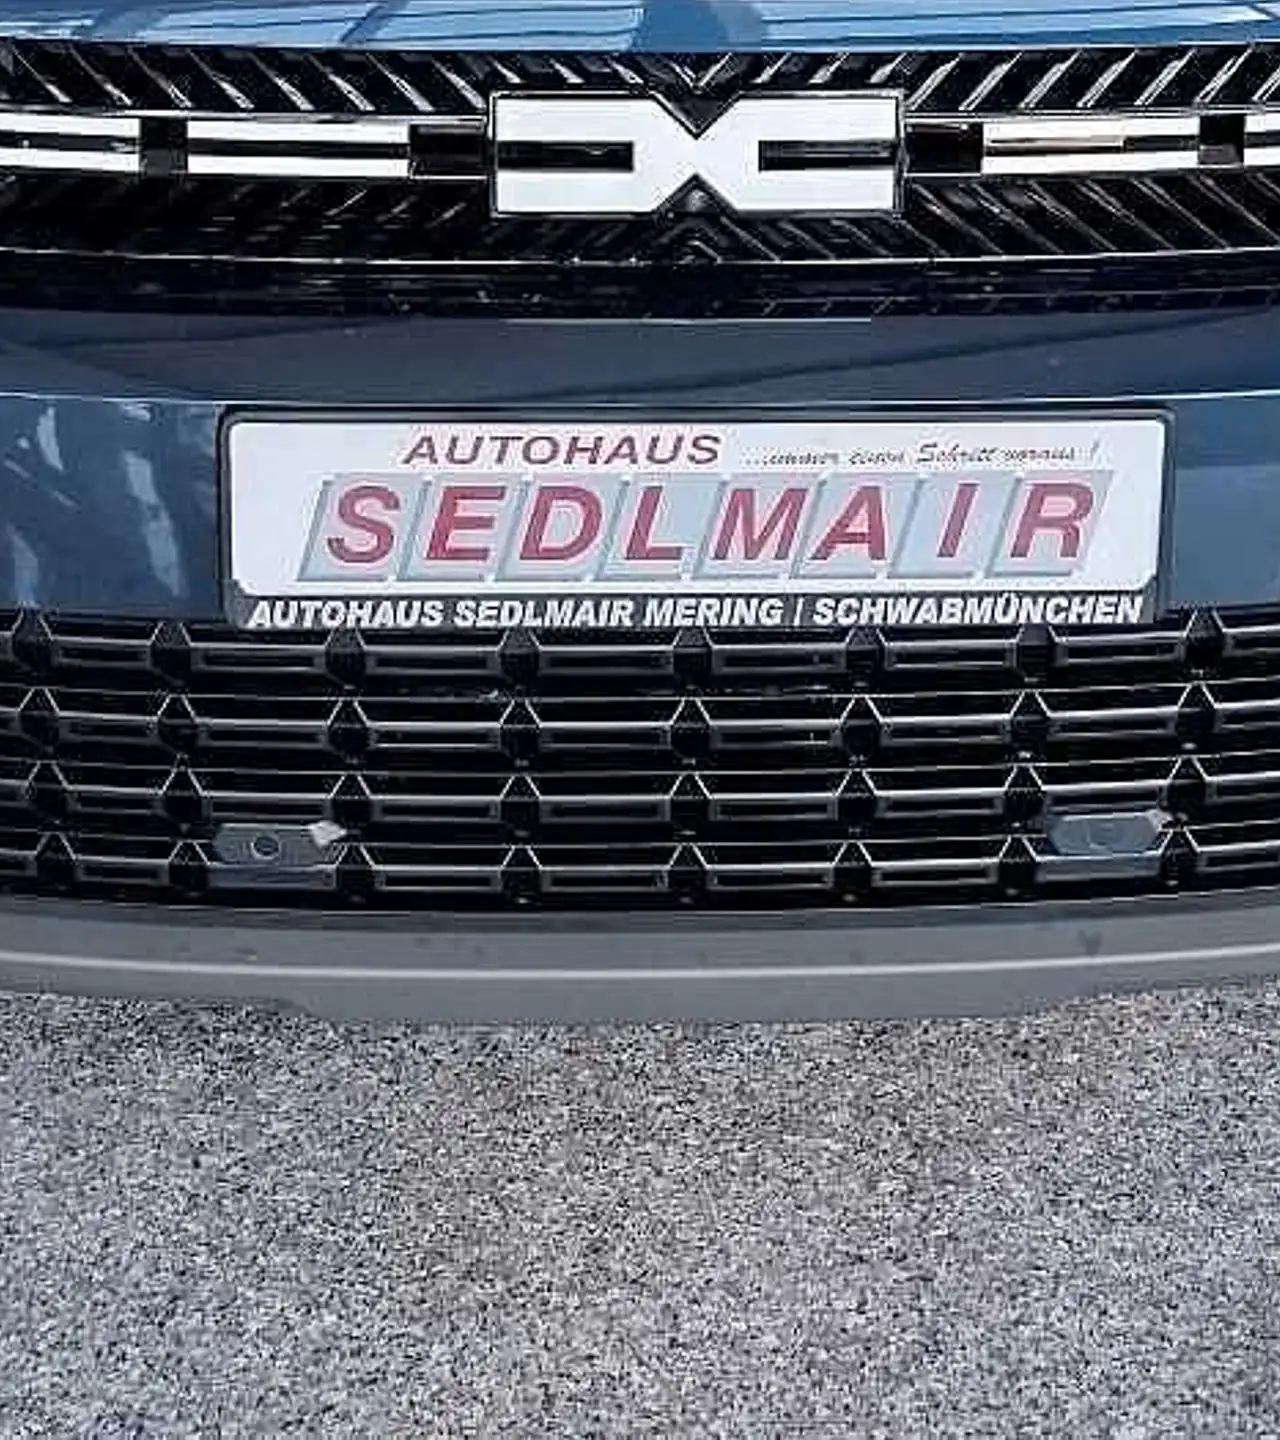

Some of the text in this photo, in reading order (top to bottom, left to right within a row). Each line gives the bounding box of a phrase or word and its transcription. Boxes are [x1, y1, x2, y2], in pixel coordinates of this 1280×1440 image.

[401, 434, 722, 466] AUTOHAUS
[326, 481, 1095, 565] SEDLMAIR
[247, 598, 445, 629] AUTOHAUS
[453, 598, 635, 628] SEDLMAIR
[643, 597, 785, 627] MERING
[812, 592, 1144, 625] SCHWABMÜNCHEN
